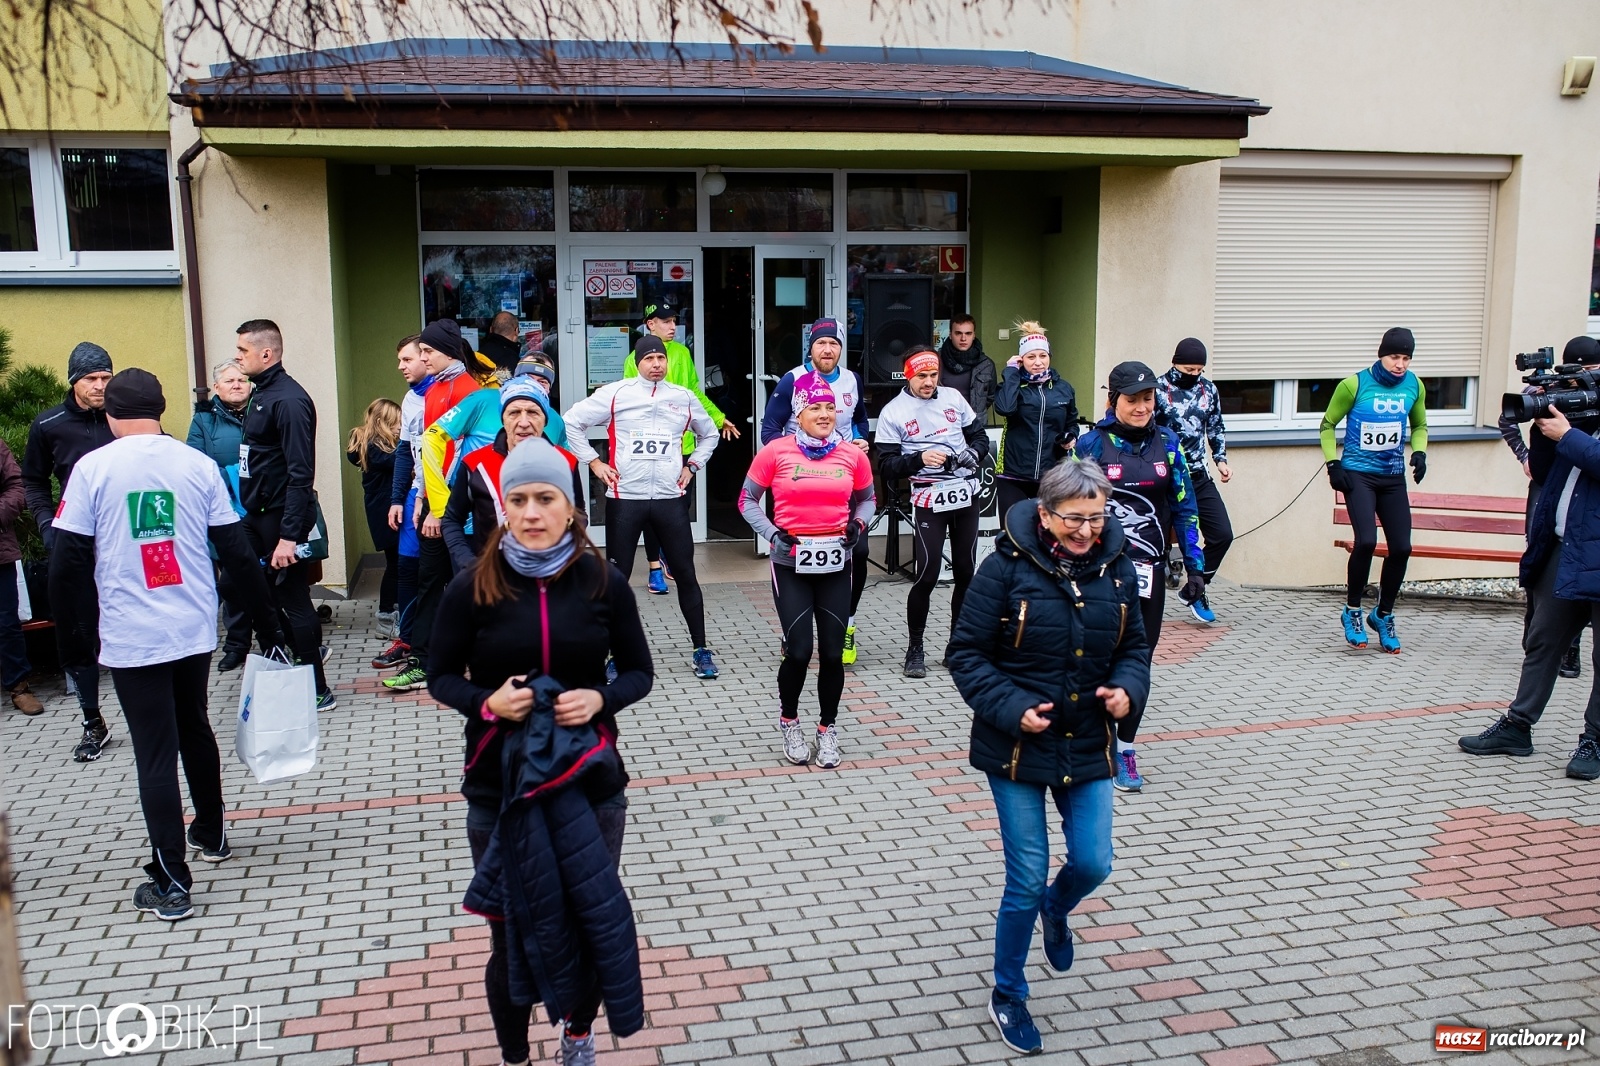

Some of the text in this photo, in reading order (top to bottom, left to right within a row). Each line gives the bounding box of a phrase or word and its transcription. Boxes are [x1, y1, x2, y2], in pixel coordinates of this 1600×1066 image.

[1373, 398, 1407, 414] bbl
[1363, 432, 1399, 445] 304
[632, 440, 670, 455] 267
[800, 467, 833, 475] Kobiety
[934, 488, 969, 506] 463
[138, 528, 173, 538] Athletics
[799, 549, 842, 567] 293
